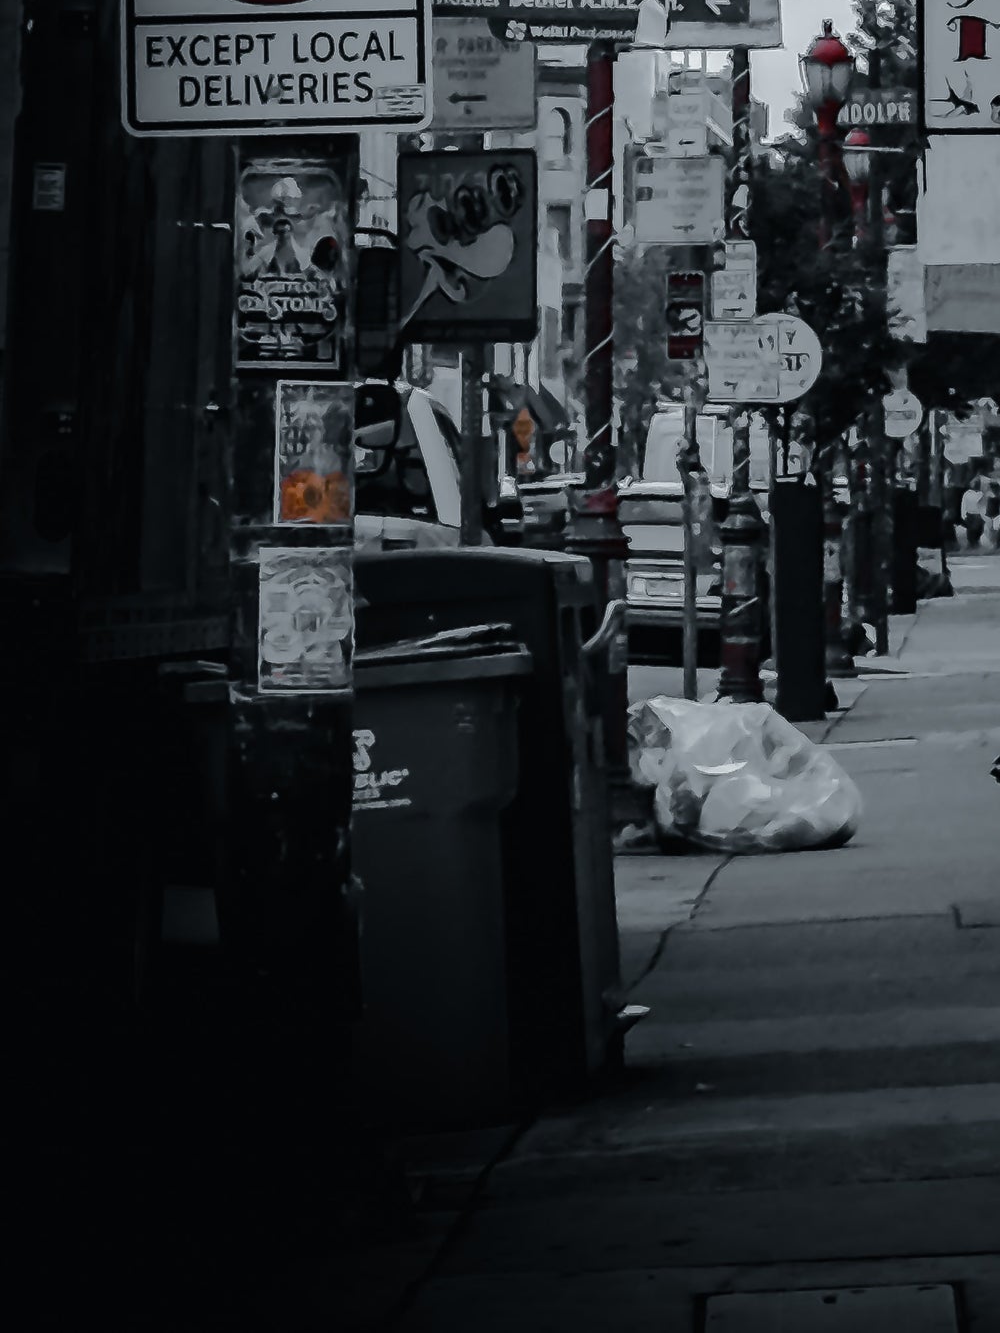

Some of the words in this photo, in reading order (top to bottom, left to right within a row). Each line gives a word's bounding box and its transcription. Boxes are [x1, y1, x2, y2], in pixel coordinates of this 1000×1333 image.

[146, 33, 275, 67] EXCEPT
[292, 31, 404, 63] LOCAL
[178, 71, 373, 108] DELIVERIES
[813, 102, 911, 125] NDOLPH
